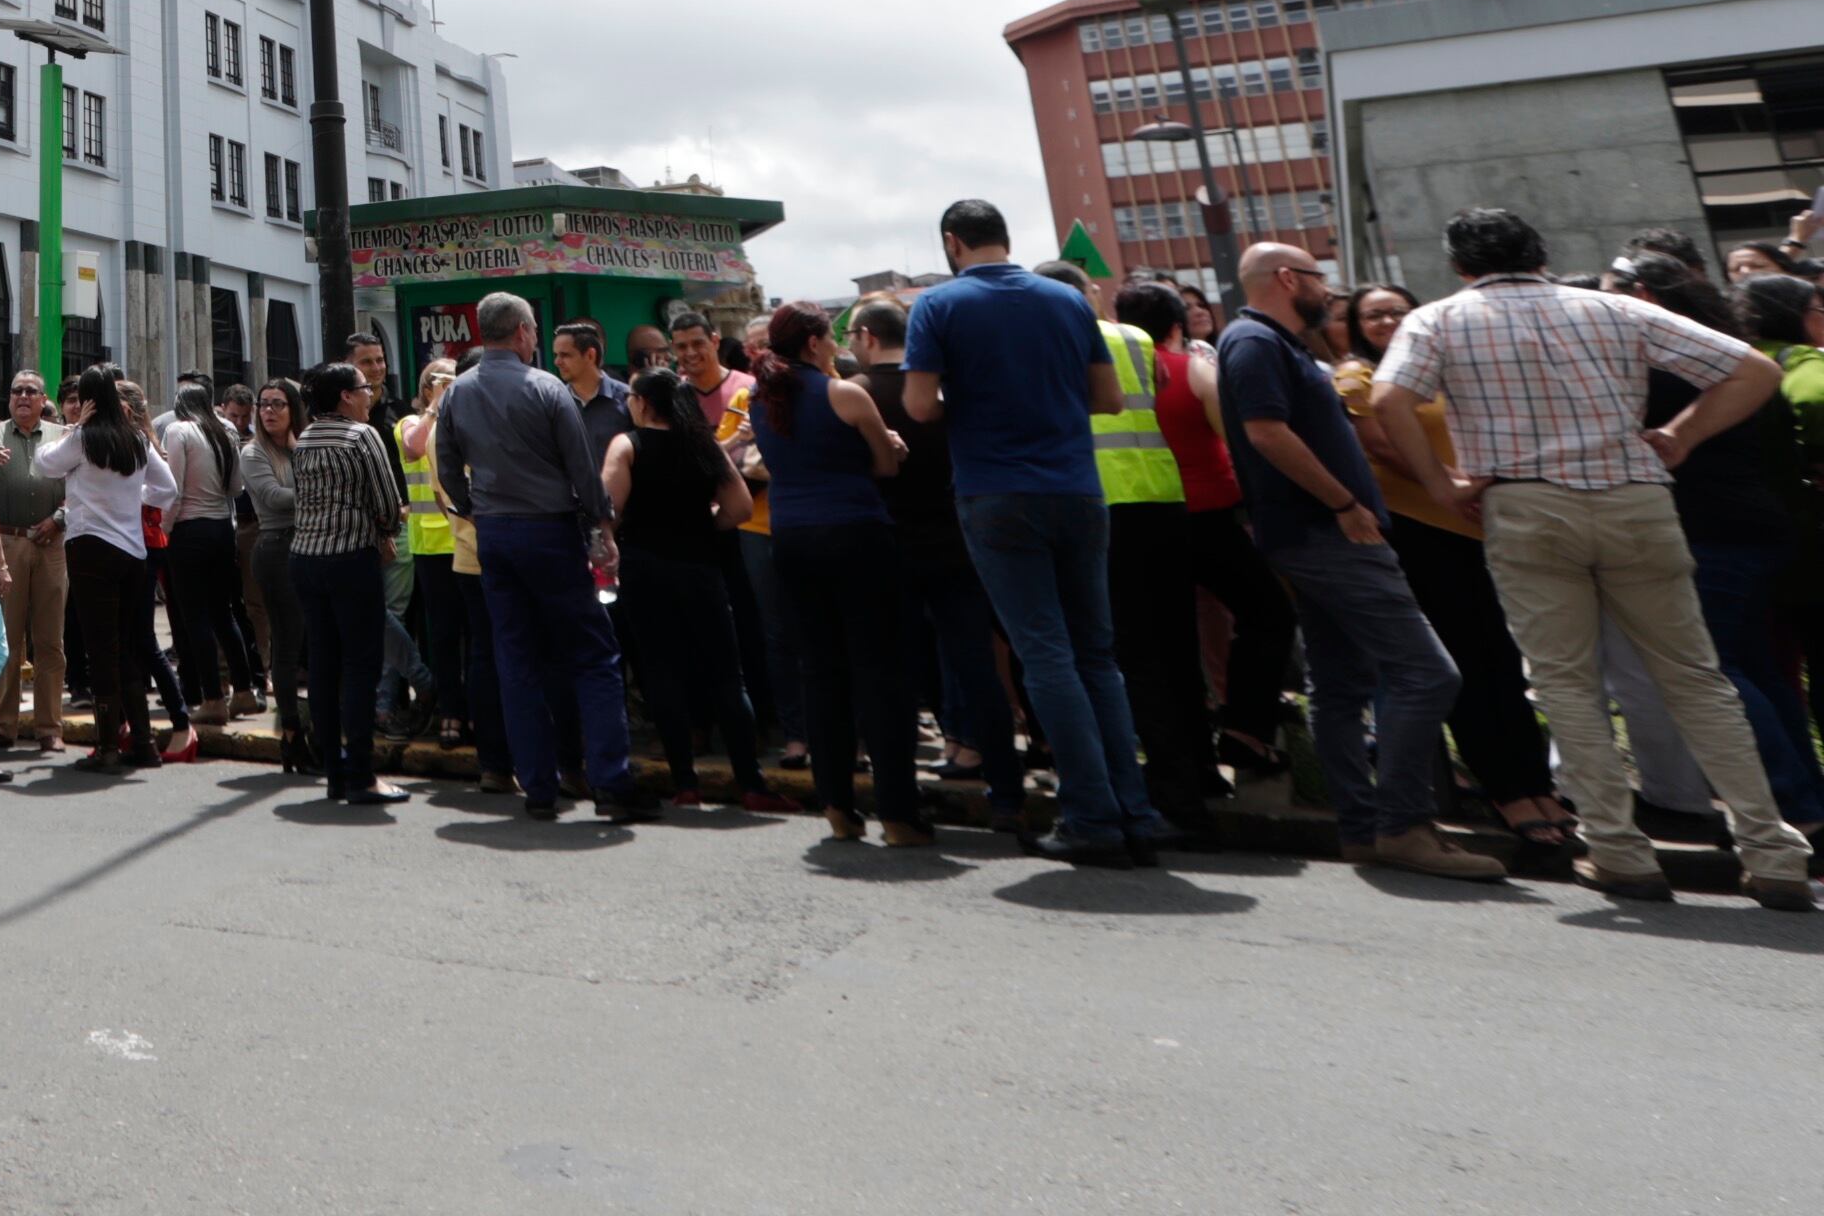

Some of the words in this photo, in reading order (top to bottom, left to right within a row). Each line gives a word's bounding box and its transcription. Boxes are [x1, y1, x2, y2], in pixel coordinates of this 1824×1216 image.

[350, 227, 412, 249] TIEMPOS
[493, 214, 544, 237] LOTTO
[691, 224, 734, 243] LOTTO
[374, 254, 441, 277] CHANCES
[456, 248, 520, 271] LOTERIA
[587, 245, 649, 268] CHANCES
[662, 251, 718, 272] LOTERIA
[419, 314, 471, 343] PURA
